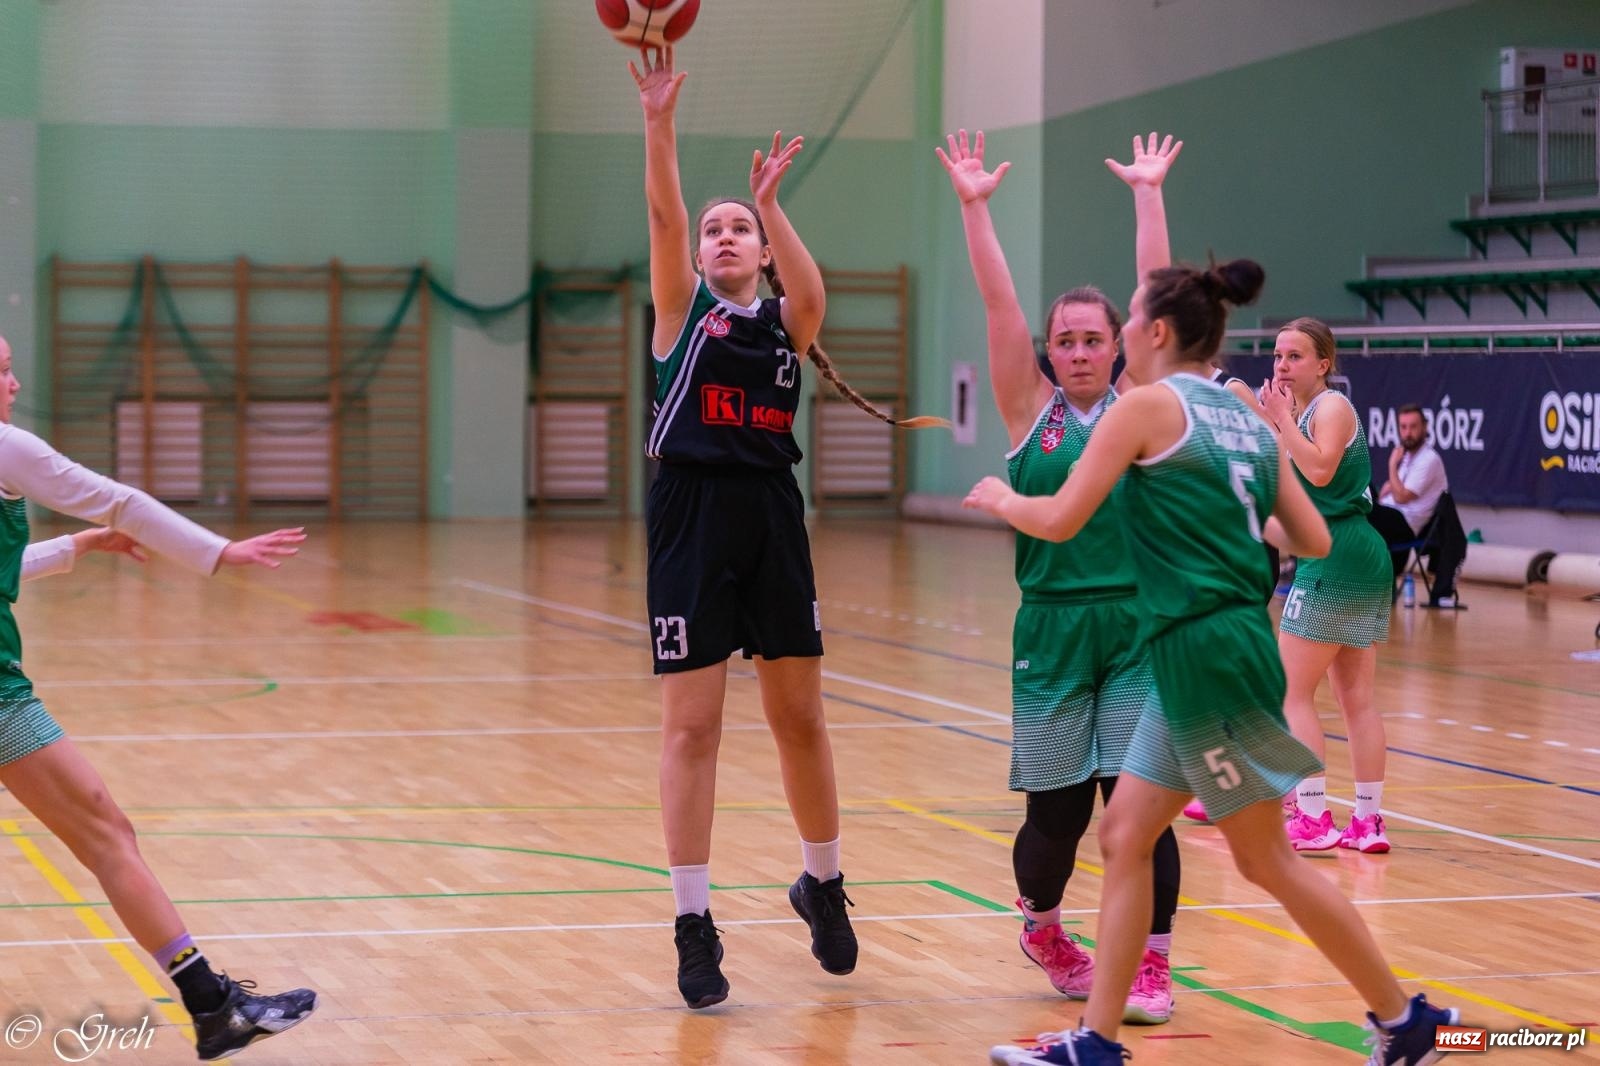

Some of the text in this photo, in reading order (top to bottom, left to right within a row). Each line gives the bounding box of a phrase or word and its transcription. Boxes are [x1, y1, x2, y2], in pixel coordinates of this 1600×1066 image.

[706, 390, 738, 421] K
[1368, 394, 1485, 451] RABÓRZ
[654, 615, 689, 660] 23
[1203, 746, 1243, 790] 5
